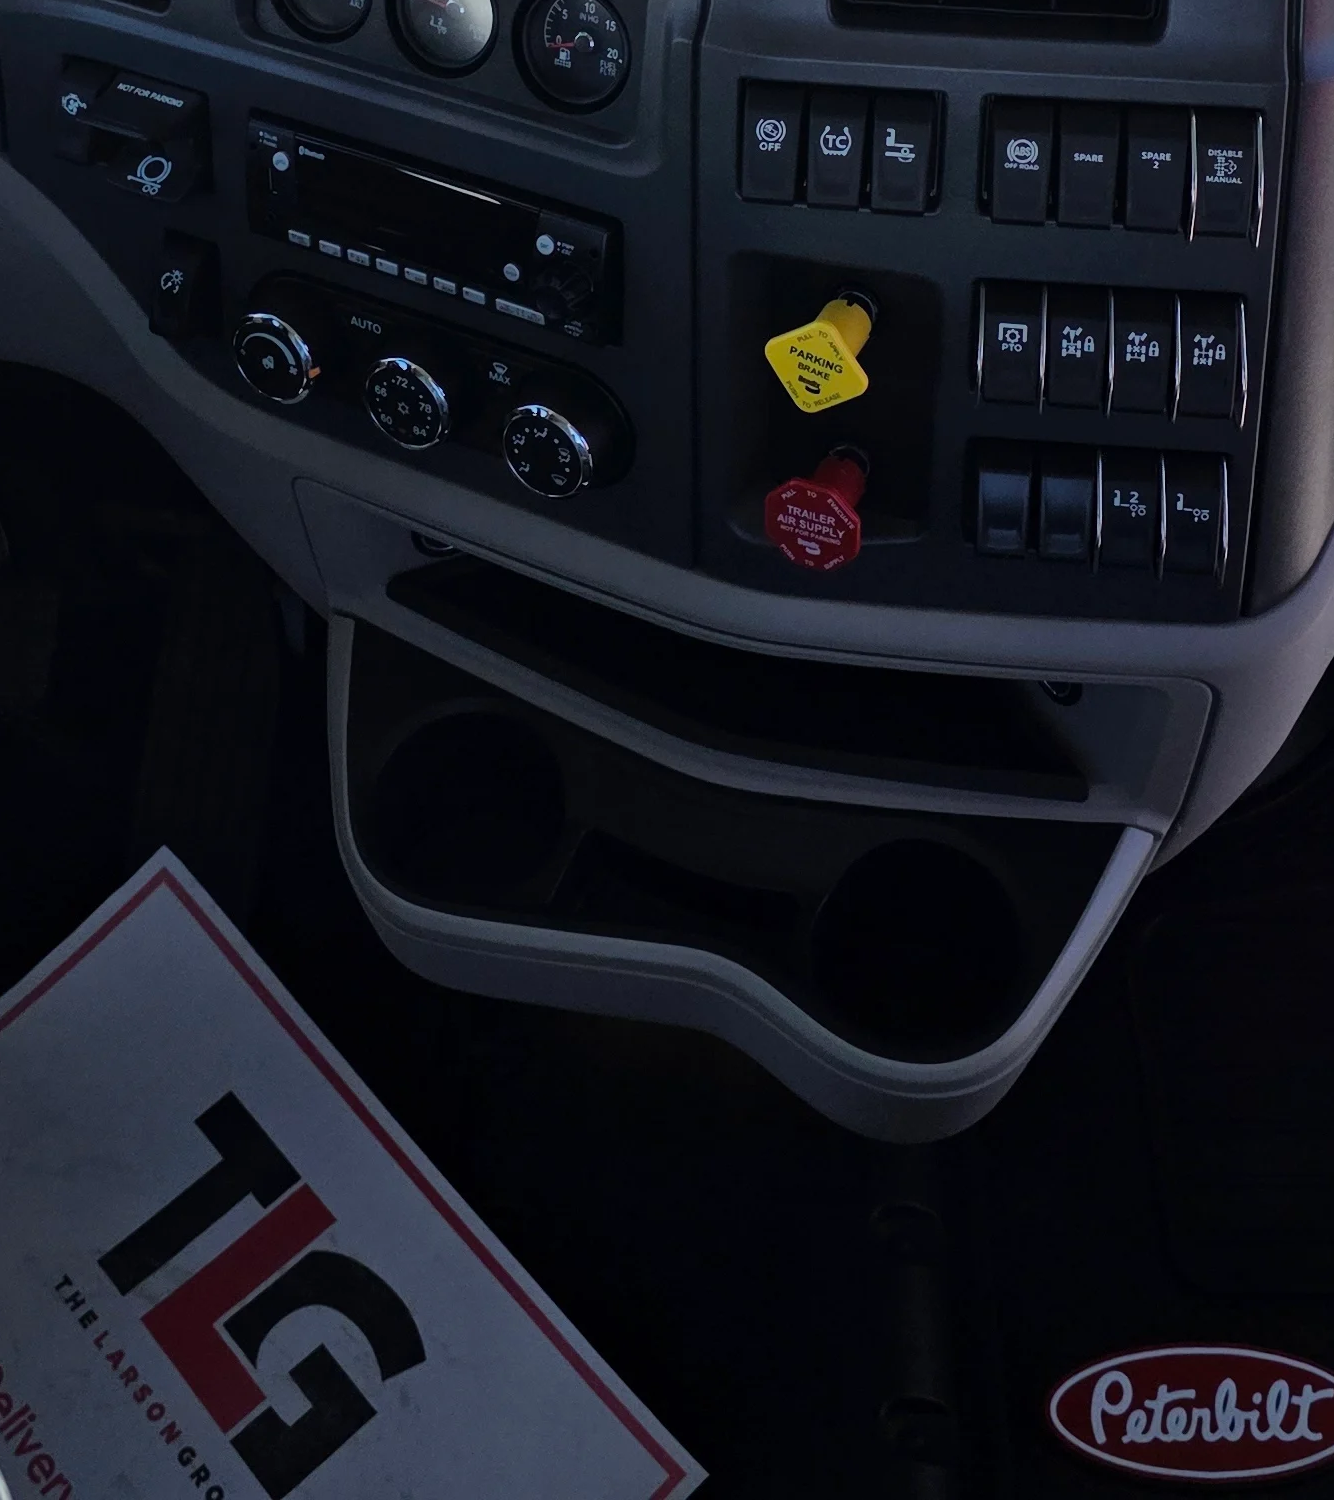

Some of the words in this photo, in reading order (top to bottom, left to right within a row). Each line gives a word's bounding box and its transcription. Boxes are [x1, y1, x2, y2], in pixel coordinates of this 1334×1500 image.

[584, 2, 596, 14] 10
[605, 20, 616, 32] 15
[607, 47, 619, 60] 20
[117, 82, 136, 93] NOT
[133, 87, 151, 98] FOR
[759, 142, 782, 152] OFF
[825, 134, 847, 149] TC
[1074, 153, 1104, 163] SPARE
[1141, 151, 1172, 162] SPARE
[1207, 148, 1243, 159] DISABLE
[1019, 163, 1040, 171] ROAD
[1152, 161, 1160, 169] 2
[1206, 175, 1243, 185] MANUAL
[350, 315, 382, 335] AUTO
[796, 333, 814, 343] PULL
[1001, 342, 1023, 352] PTO
[789, 345, 844, 374] PARKING
[489, 370, 512, 386] MAX
[797, 362, 831, 381] BRAKE
[396, 375, 409, 389] 72
[418, 401, 432, 414] 78
[380, 413, 393, 425] 60
[412, 425, 427, 437] 84
[787, 504, 836, 527] TRAILER
[827, 498, 855, 530] EVACUATE
[776, 513, 796, 527] AIR
[799, 519, 846, 539] SUPPLY
[810, 532, 841, 546] PARKING
[98, 1091, 427, 1500] TLG
[53, 1273, 99, 1329] THE
[93, 1329, 183, 1445] LARSON
[1090, 1370, 1334, 1445] Peterbilt
